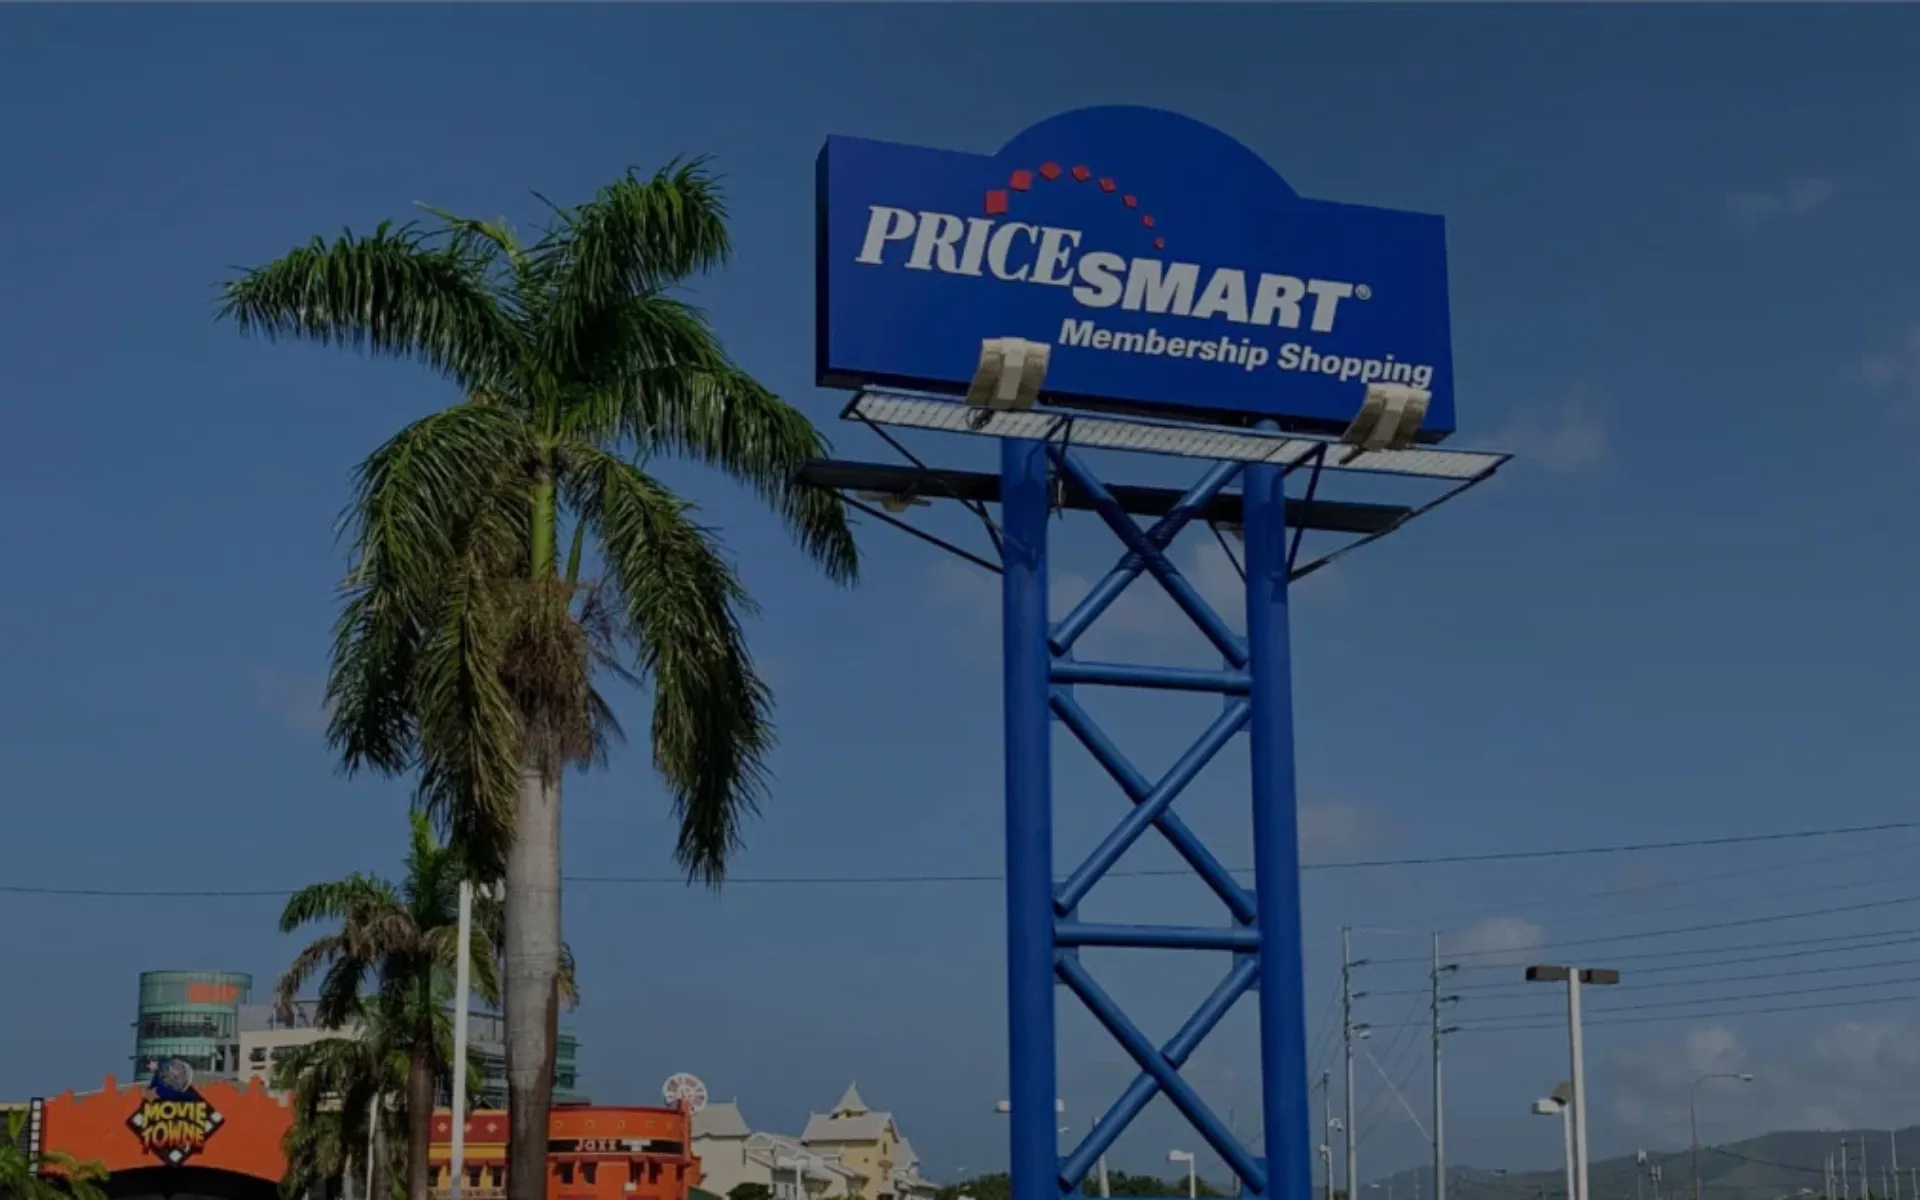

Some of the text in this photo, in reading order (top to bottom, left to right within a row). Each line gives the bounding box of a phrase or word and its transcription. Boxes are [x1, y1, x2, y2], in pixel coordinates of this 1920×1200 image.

[1058, 318, 1434, 389] Membership Shopping
[142, 1101, 206, 1128] MOVIE
[142, 1120, 205, 1149] TOWNE
